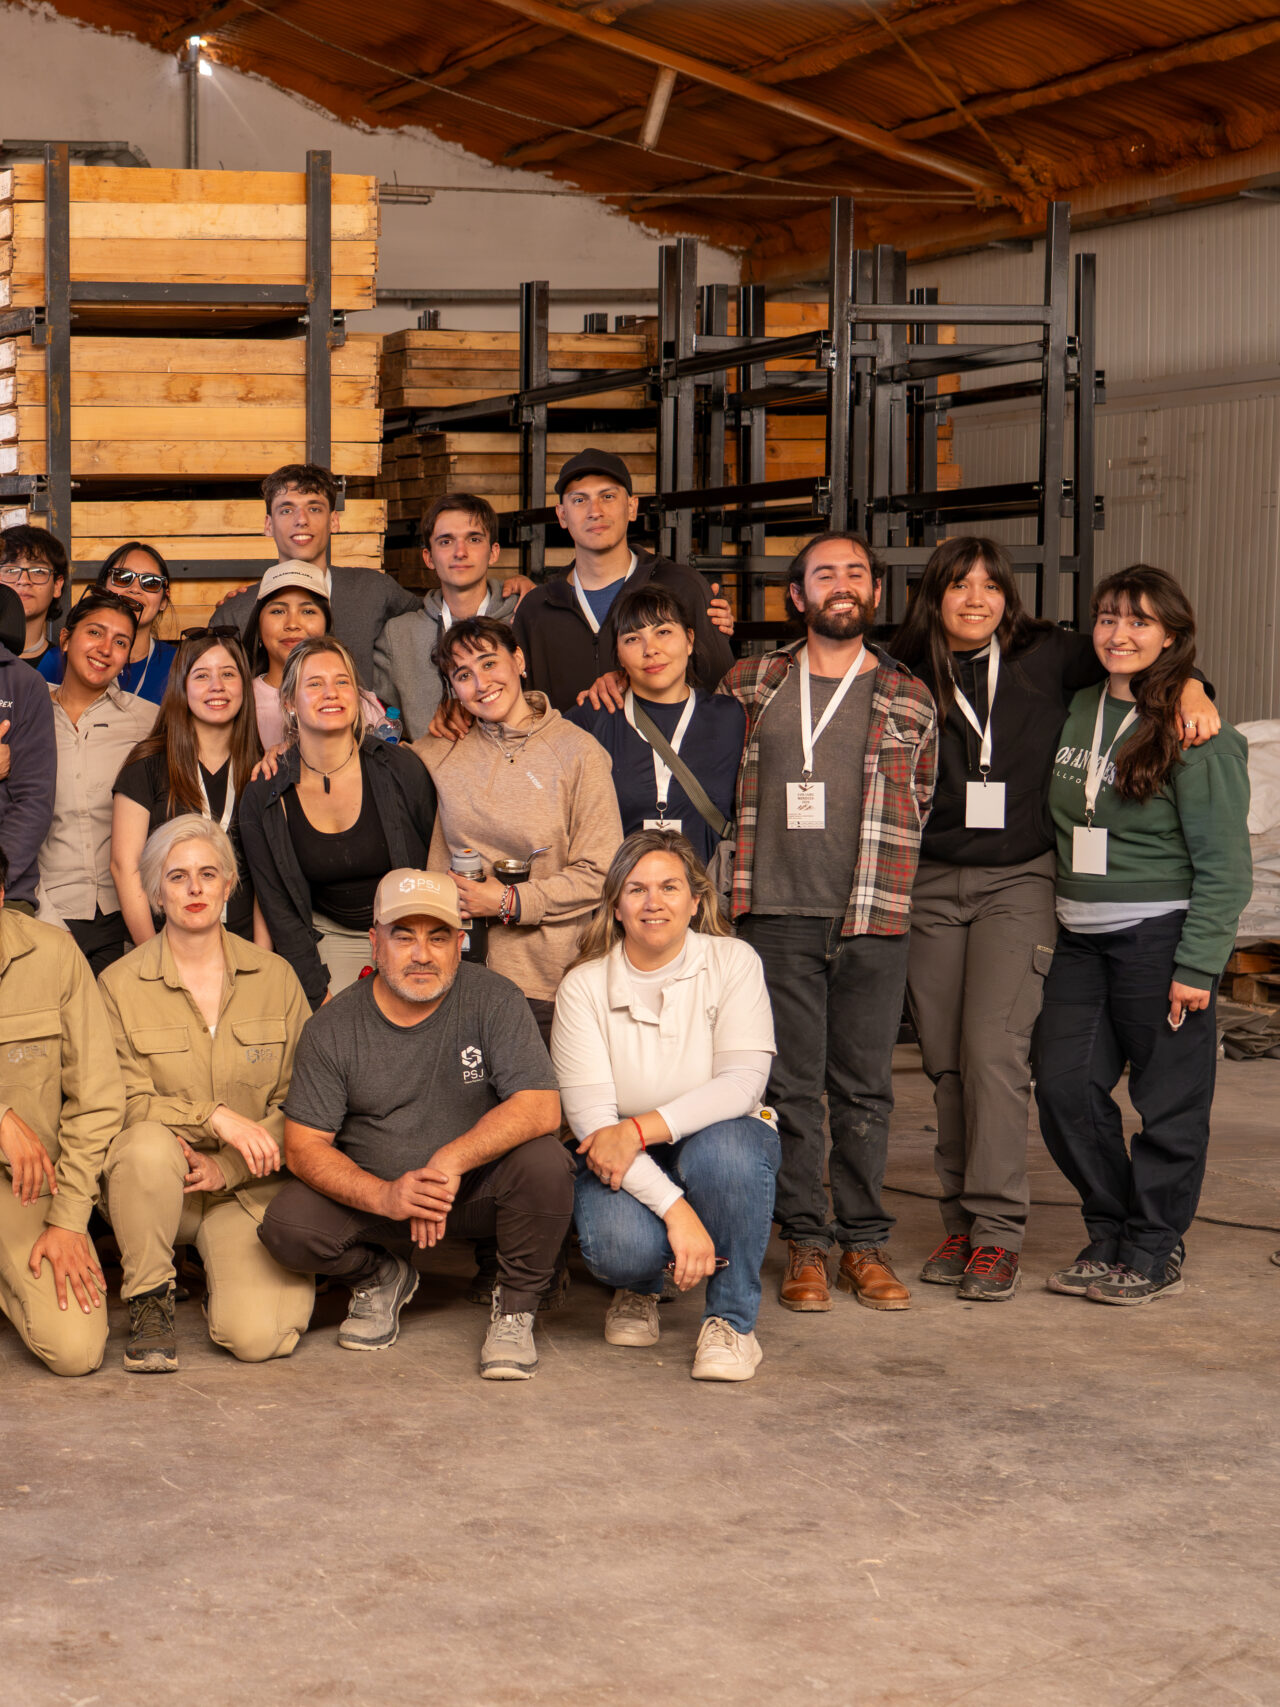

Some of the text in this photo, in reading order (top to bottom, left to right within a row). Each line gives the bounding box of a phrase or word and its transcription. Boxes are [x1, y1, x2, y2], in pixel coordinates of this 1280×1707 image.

[1055, 746, 1118, 785] OS ANES
[463, 1068, 484, 1081] PSJ
